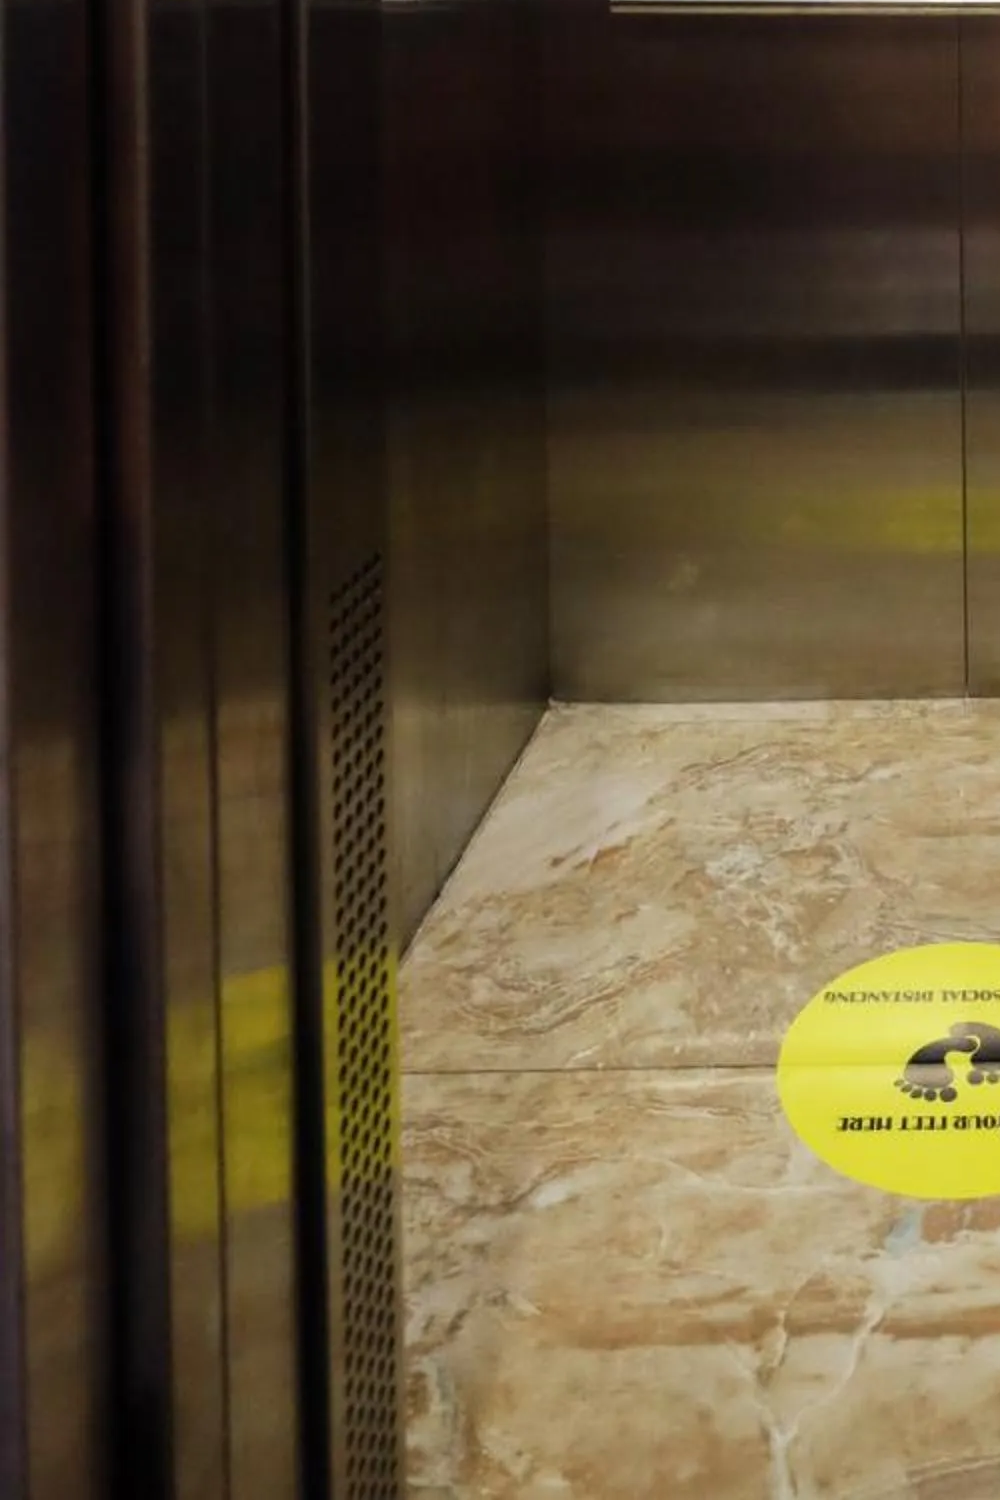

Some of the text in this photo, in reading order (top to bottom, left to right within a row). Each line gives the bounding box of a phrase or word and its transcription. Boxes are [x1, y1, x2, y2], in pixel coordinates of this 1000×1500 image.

[823, 990, 935, 1004] DISTANCING
[837, 1116, 893, 1132] HERE
[899, 1115, 948, 1131] FEET
